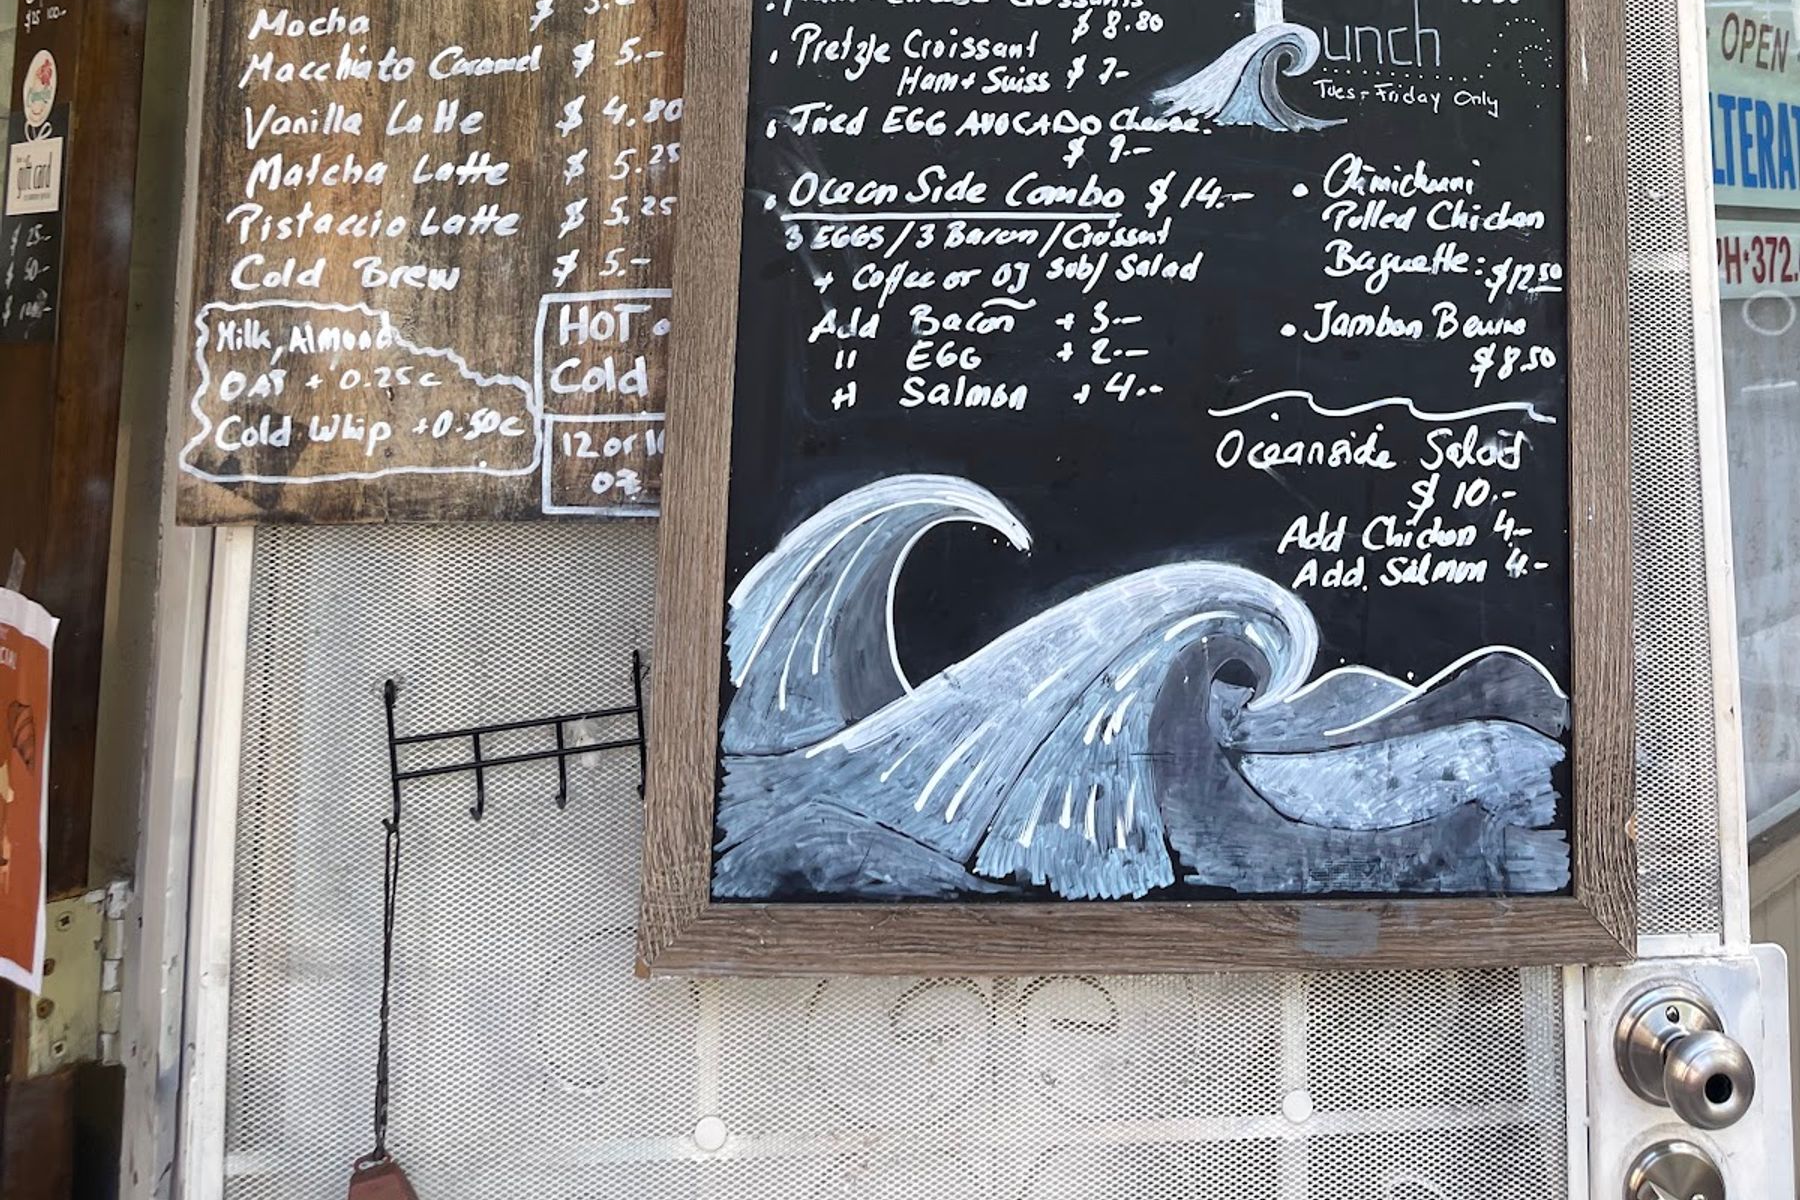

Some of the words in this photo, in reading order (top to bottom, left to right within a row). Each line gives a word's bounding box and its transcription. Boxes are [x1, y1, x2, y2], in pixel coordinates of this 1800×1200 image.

[247, 8, 370, 41] Mocha
[903, 28, 1038, 60] Croissant
[1721, 12, 1790, 73] OPEN
[238, 42, 415, 88] Macchiato
[881, 106, 947, 137] EGG
[1453, 91, 1499, 118] Only
[245, 102, 361, 150] Vanilla
[246, 152, 386, 198] Matcha
[412, 151, 509, 186] Latte
[789, 171, 898, 208] Ocean
[904, 165, 988, 206] Side
[1005, 172, 1125, 208] Combo
[226, 201, 404, 245] Pistaccio
[420, 204, 521, 237] Latte
[1321, 200, 1417, 232] Pulled
[231, 254, 327, 292] Cold
[354, 258, 461, 291] Brew
[852, 260, 936, 309] Coffee
[942, 269, 982, 290] or
[1115, 251, 1204, 282] Salad
[559, 303, 651, 345] HOT
[808, 307, 880, 343] Add
[909, 303, 1015, 336] Bacon
[1303, 300, 1423, 343] Jambon
[906, 339, 982, 371] EGG
[220, 369, 287, 401] OAT
[550, 355, 649, 398] Cold
[899, 375, 1028, 410] Salmon
[215, 415, 292, 451] Cold
[309, 414, 392, 456] Whip
[563, 430, 600, 458] 12
[603, 433, 638, 457] or
[1215, 424, 1397, 469] Oceanside
[1419, 424, 1531, 471] Salad
[1277, 511, 1347, 554] Add
